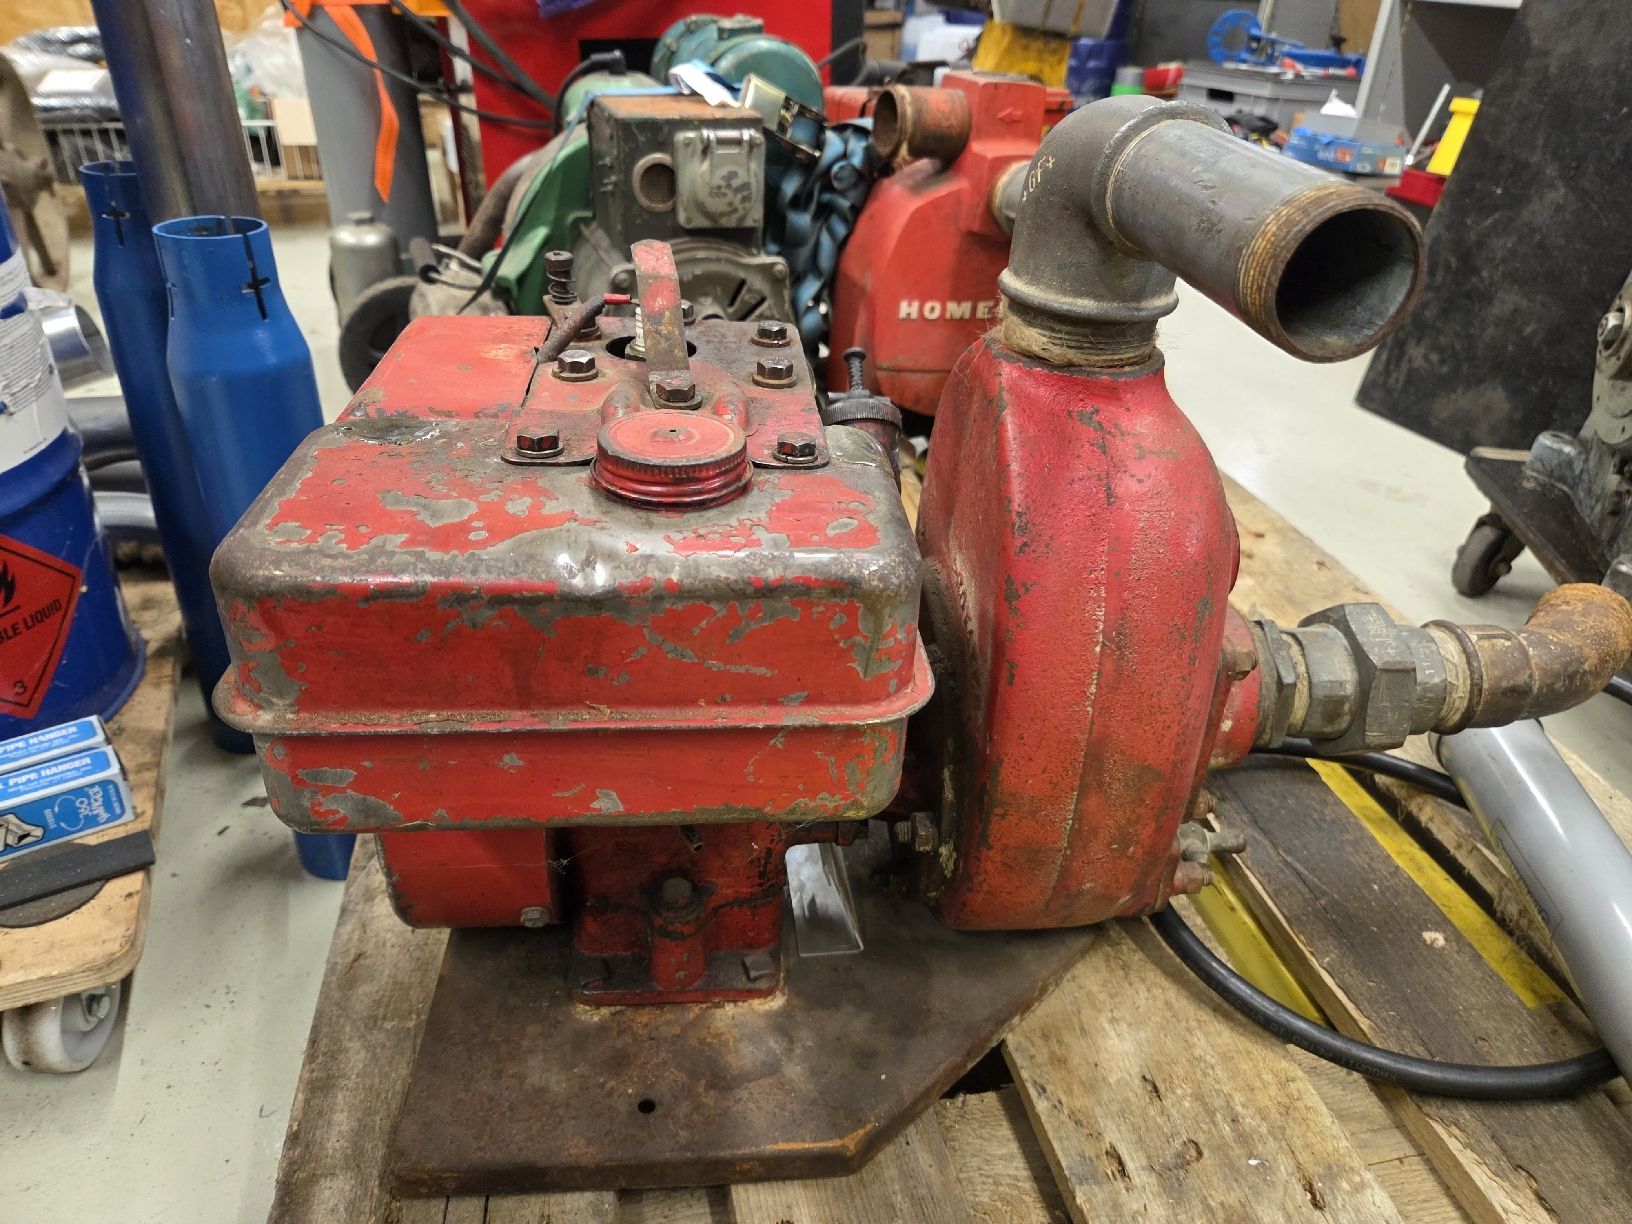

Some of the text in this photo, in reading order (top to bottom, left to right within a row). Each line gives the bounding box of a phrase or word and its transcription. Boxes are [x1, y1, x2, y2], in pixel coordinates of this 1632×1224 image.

[22, 598, 63, 630] LIQUID
[14, 679, 27, 696] 3
[28, 726, 78, 745] HANGER
[8, 772, 39, 786] PIPE
[41, 757, 92, 777] HANGER
